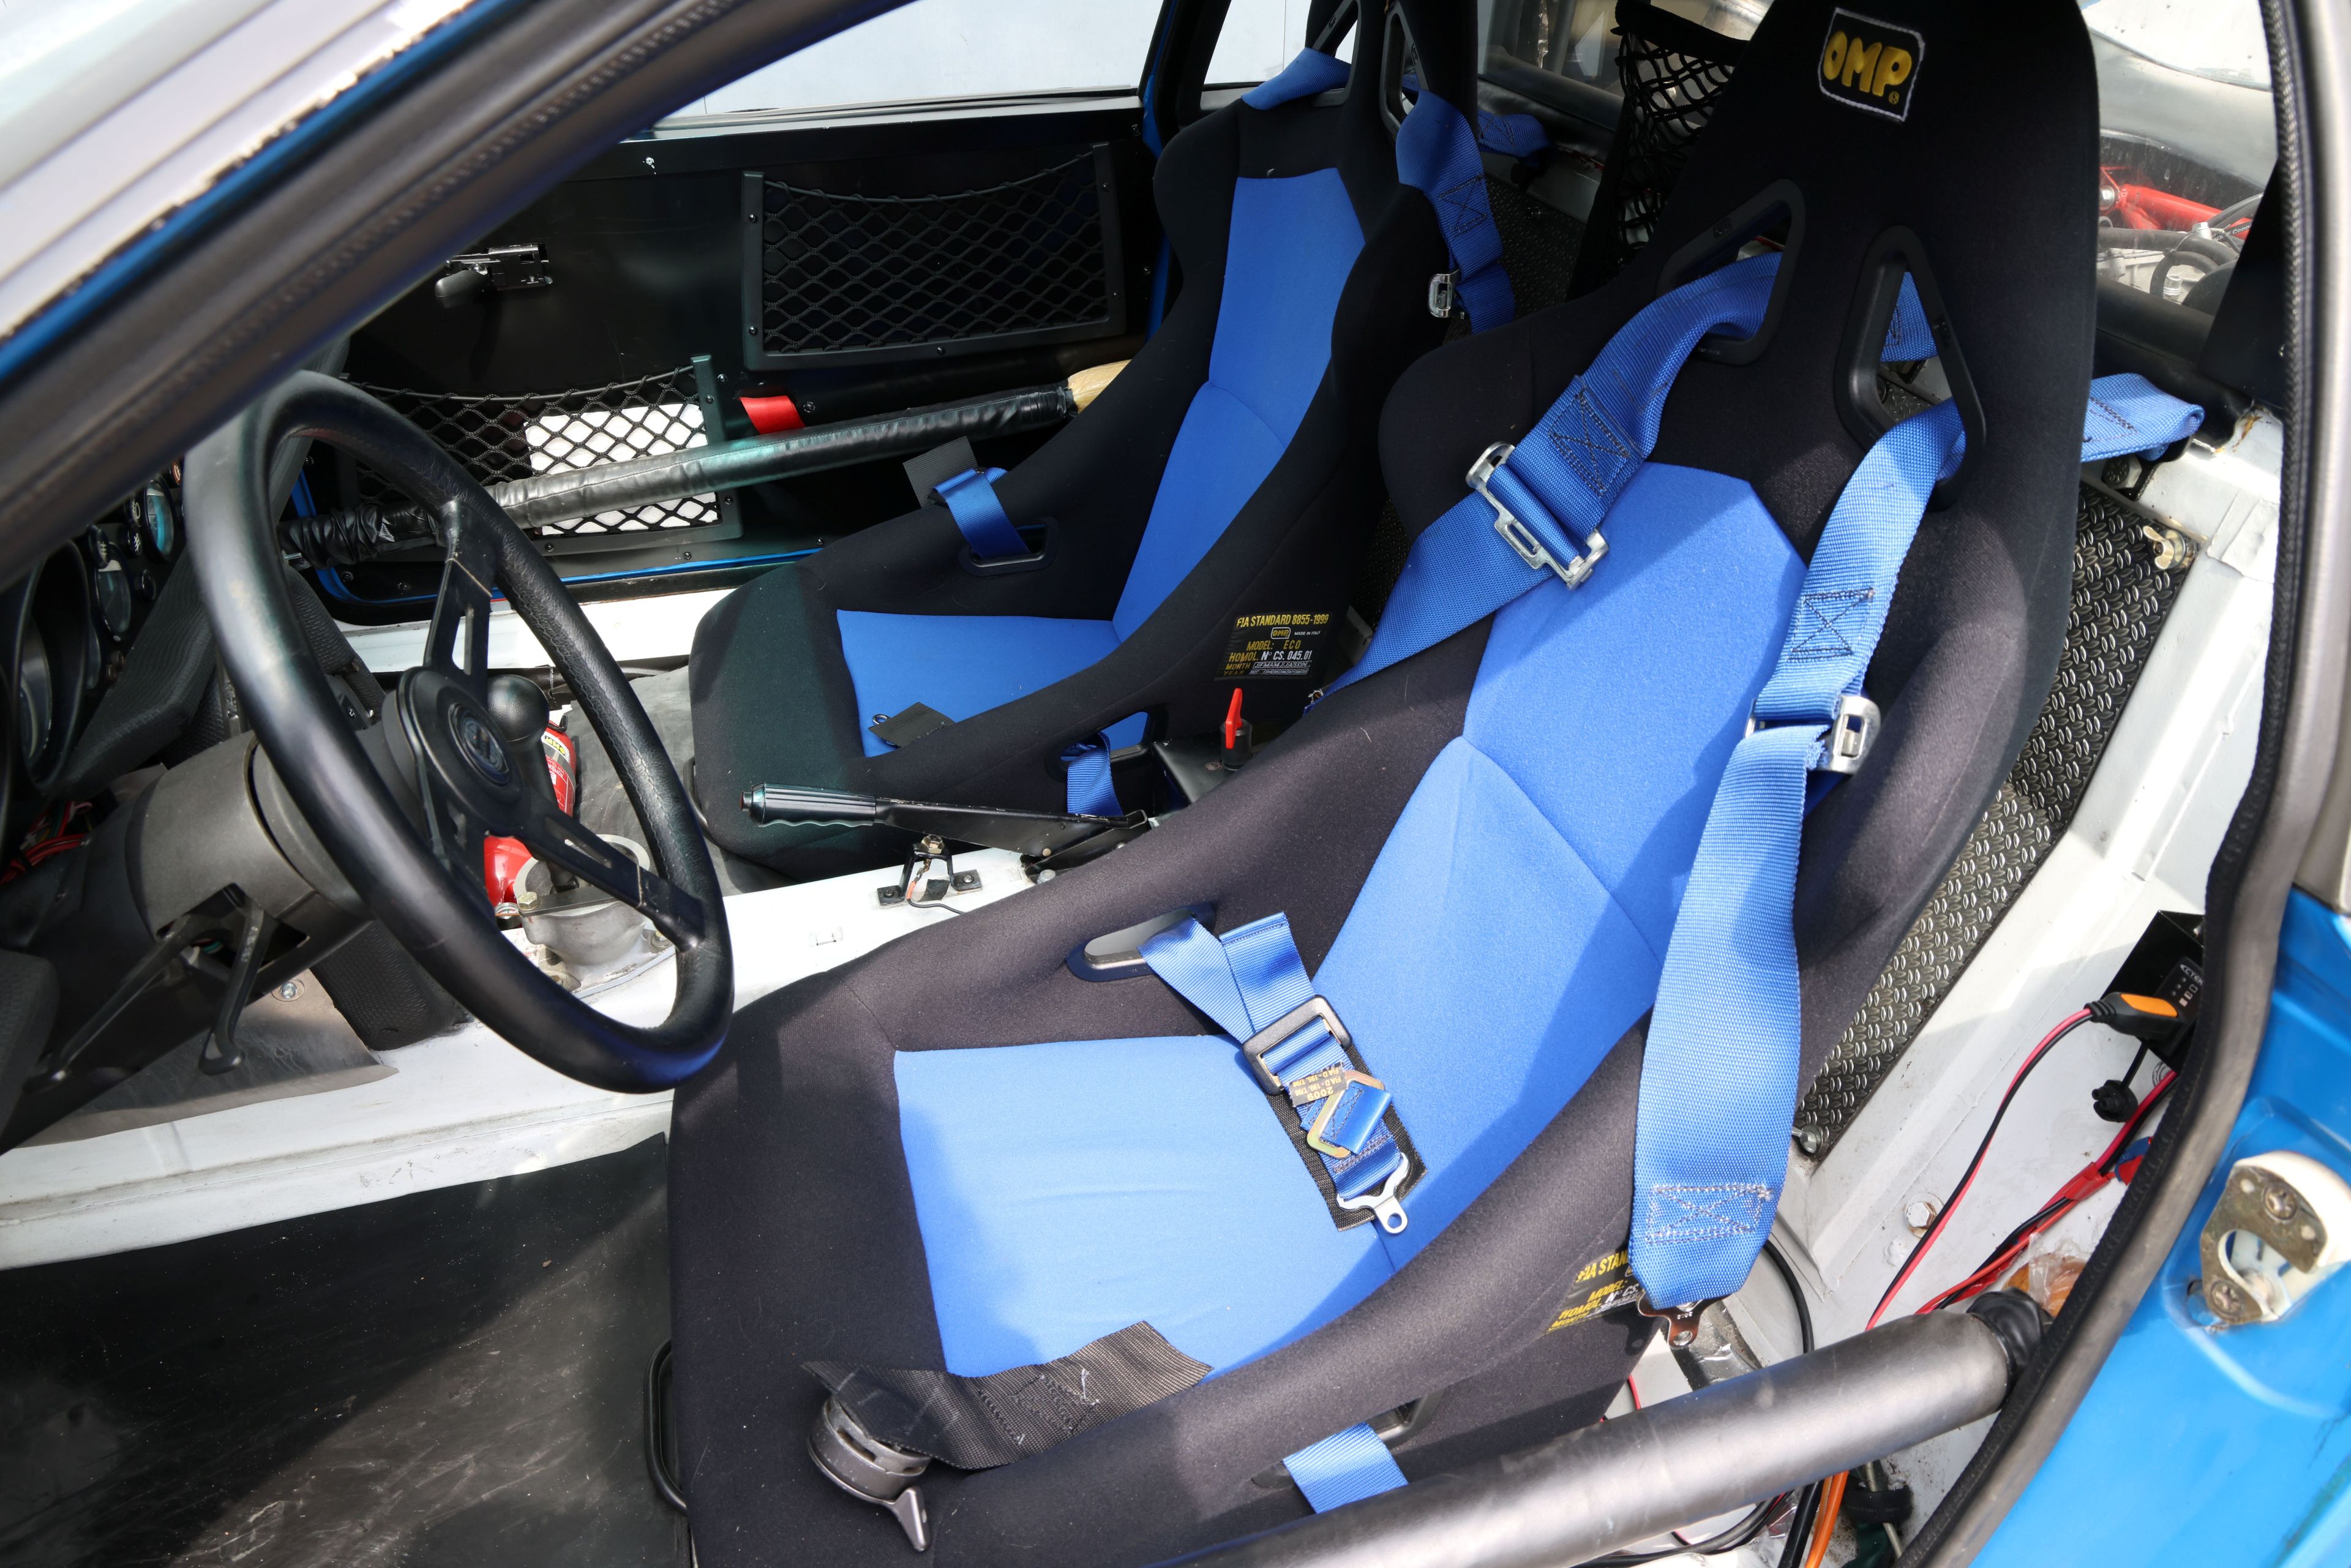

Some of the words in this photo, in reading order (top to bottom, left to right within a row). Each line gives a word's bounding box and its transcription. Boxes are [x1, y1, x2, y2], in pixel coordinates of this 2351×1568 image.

[1236, 617, 1249, 628] FIA
[1250, 614, 1291, 626] STANDARD
[1292, 614, 1329, 625] 8855-1999
[1247, 640, 1274, 651] MODEL:
[1283, 640, 1301, 650] ECO
[1229, 651, 1259, 662] HOMOL.
[1273, 651, 1284, 660] CS.
[1287, 650, 1312, 660] 045.01
[1328, 1067, 1339, 1076] FIA
[1330, 1076, 1341, 1084] FIA
[1307, 1086, 1333, 1101] 2009
[1575, 1263, 1597, 1283] FIA
